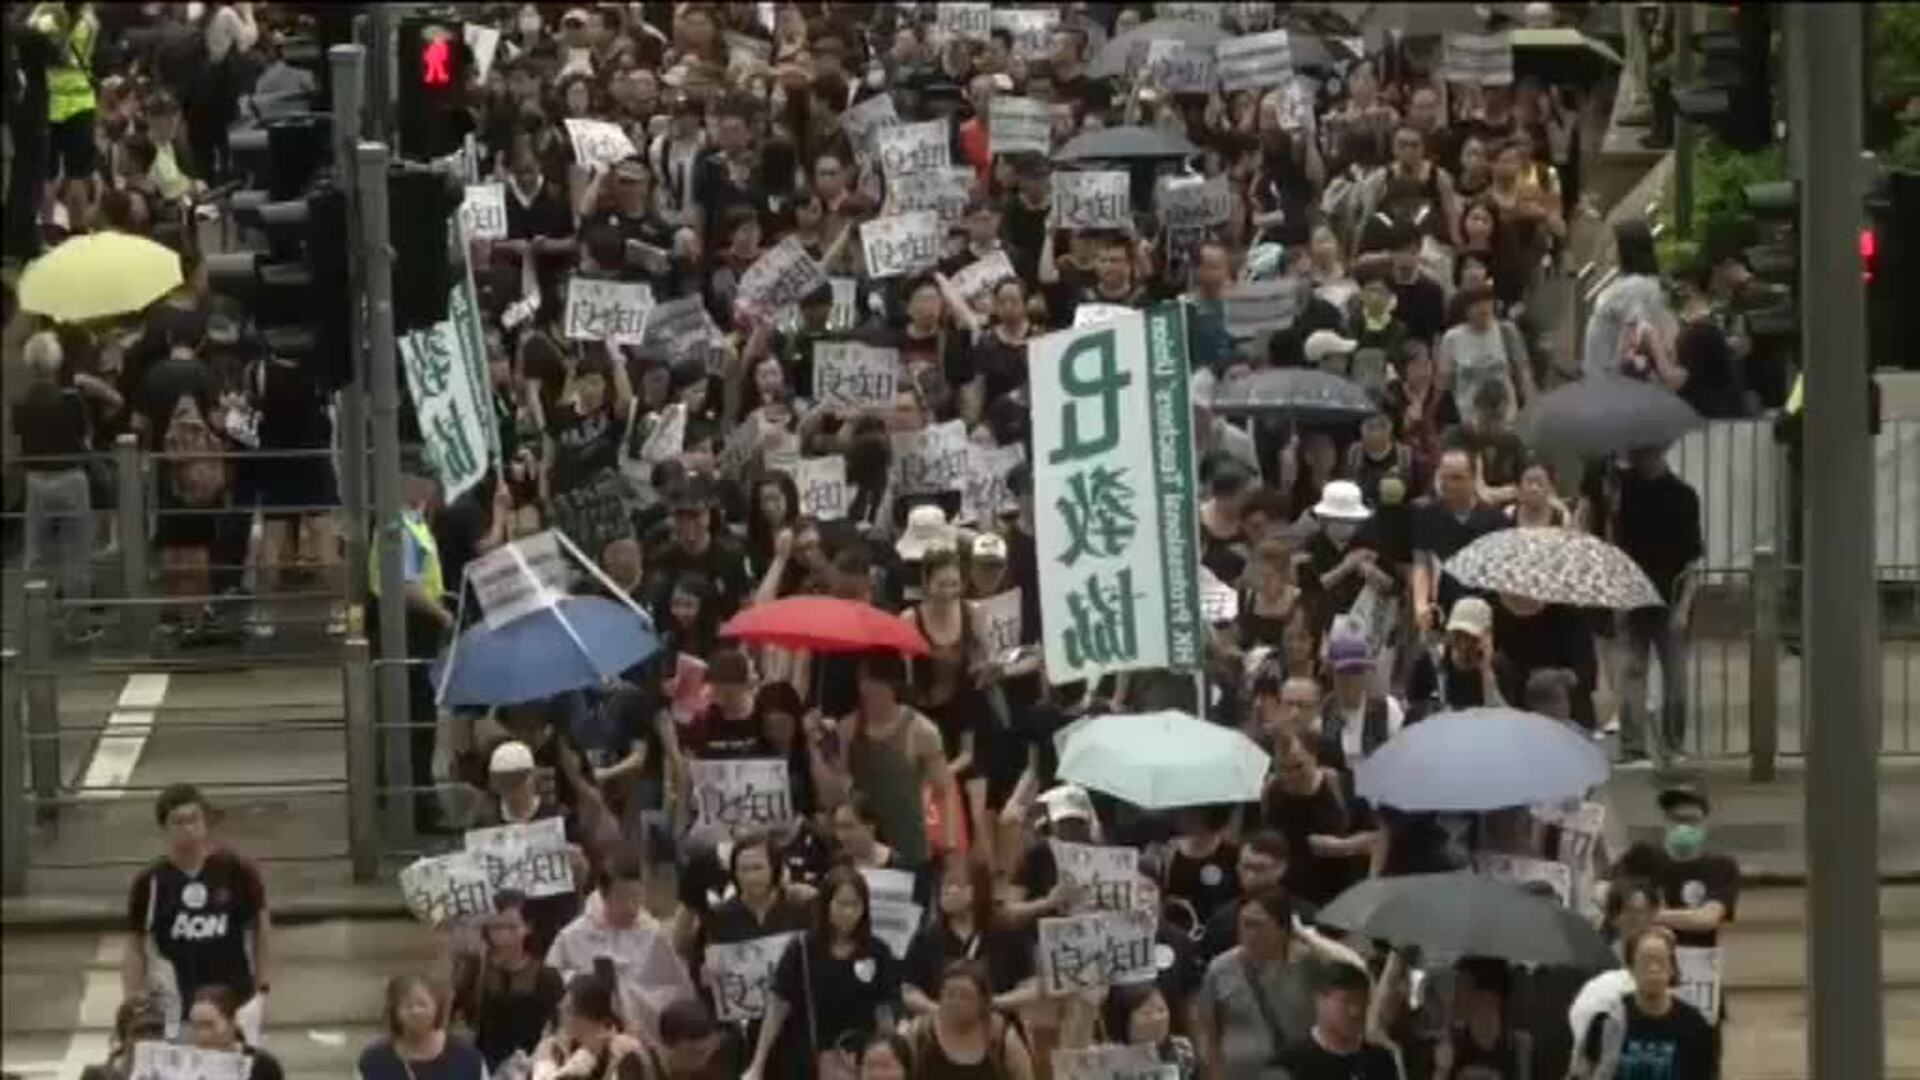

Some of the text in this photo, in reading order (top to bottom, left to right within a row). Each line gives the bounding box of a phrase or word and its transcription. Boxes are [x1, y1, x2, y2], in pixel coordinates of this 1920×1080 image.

[571, 300, 645, 334] 良知
[817, 362, 892, 402] 良知
[485, 848, 568, 889] 良知
[171, 912, 229, 940] AON
[1051, 936, 1150, 990] 良知
